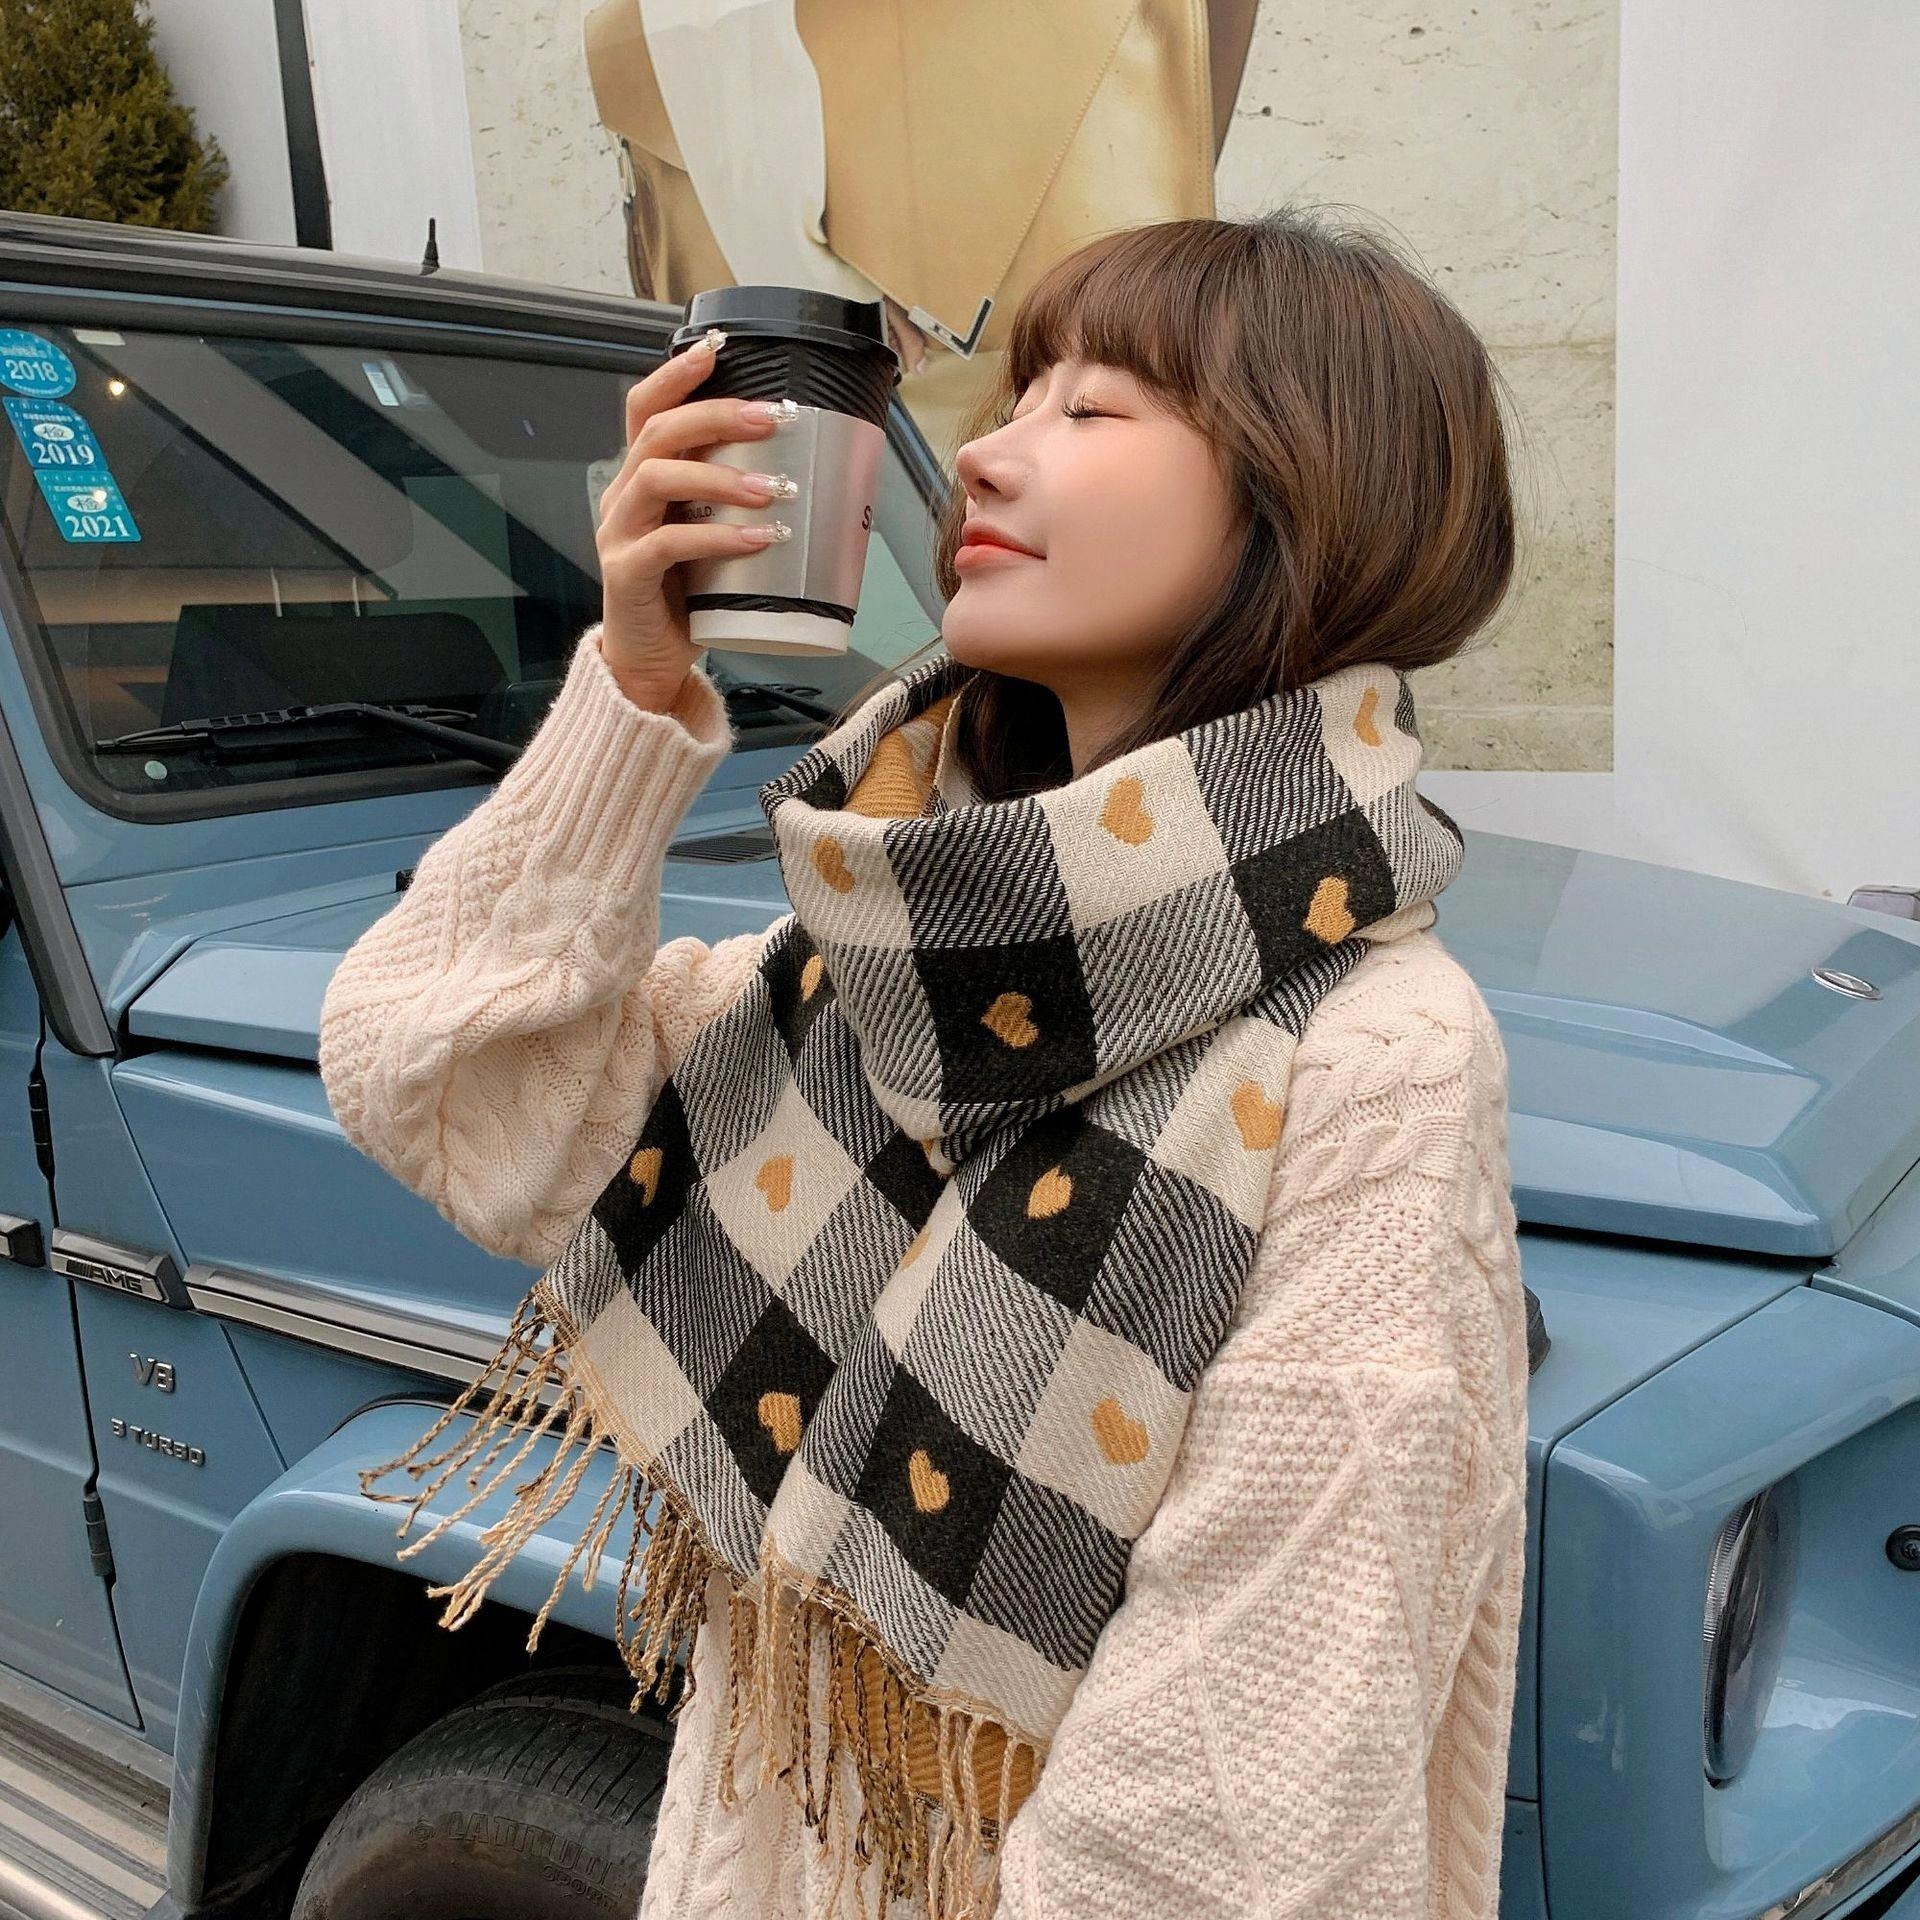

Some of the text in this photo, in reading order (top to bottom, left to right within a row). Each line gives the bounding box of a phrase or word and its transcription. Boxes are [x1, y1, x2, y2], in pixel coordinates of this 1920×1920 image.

[5, 359, 59, 382] 2018
[31, 442, 95, 466] 2019
[65, 515, 131, 537] 2021
[89, 1264, 143, 1294] AMG
[128, 1352, 175, 1393] V8
